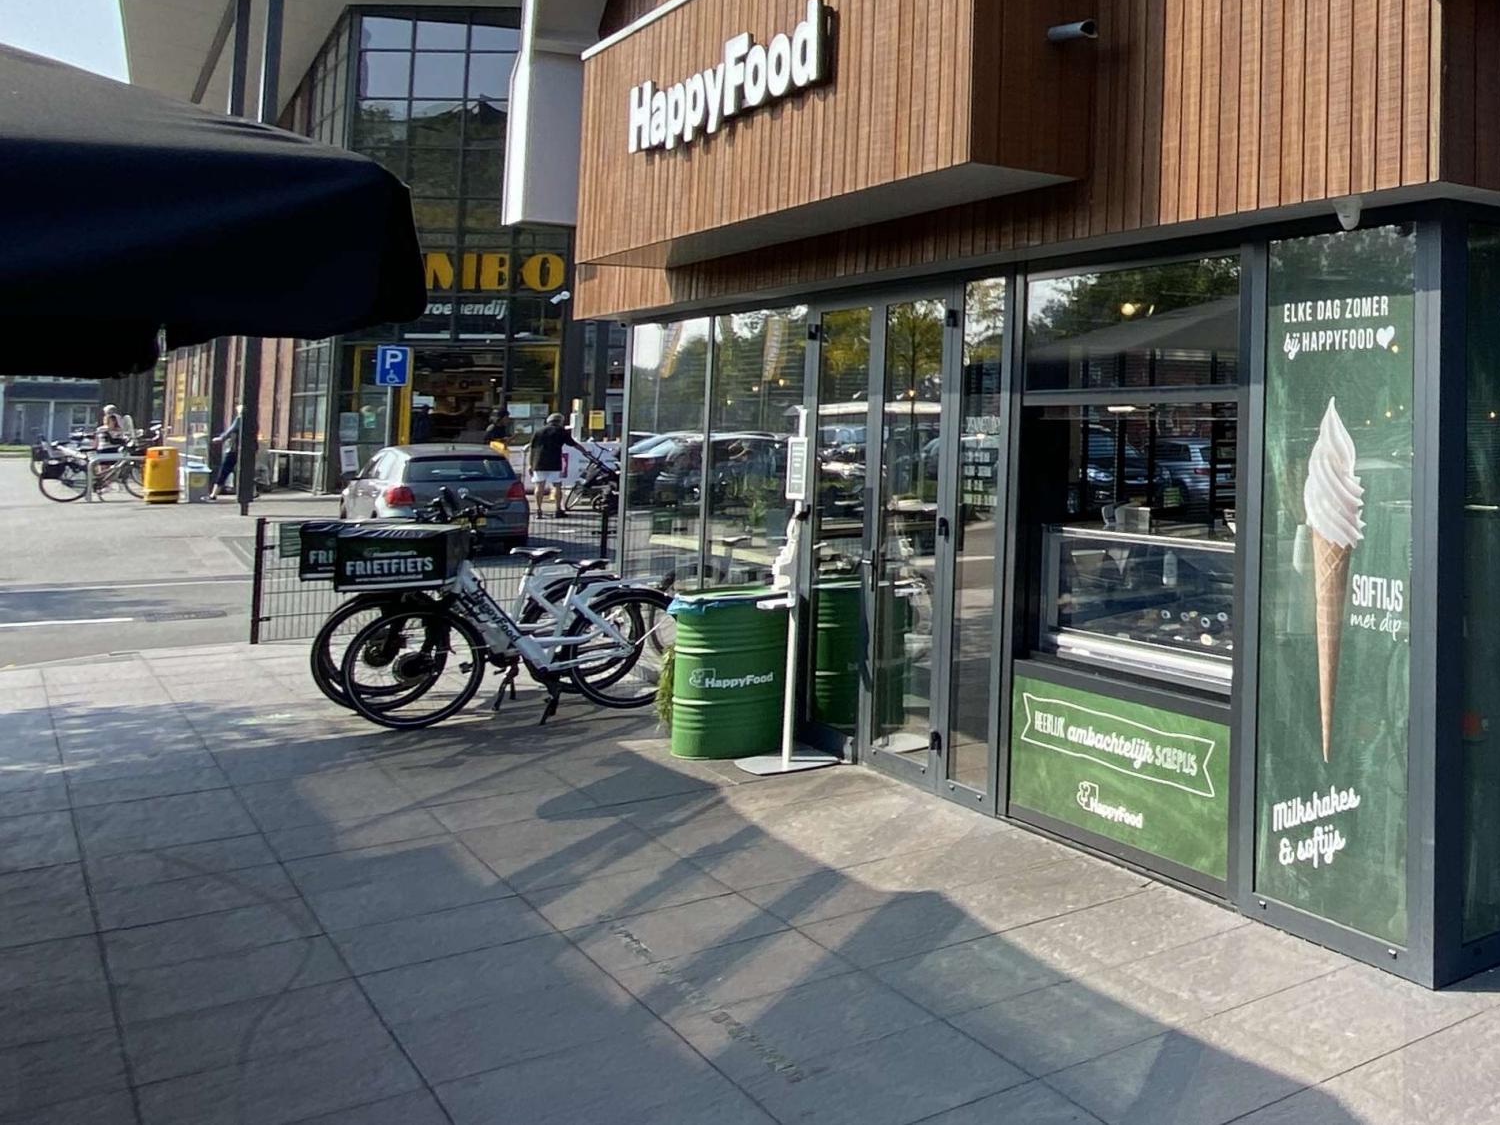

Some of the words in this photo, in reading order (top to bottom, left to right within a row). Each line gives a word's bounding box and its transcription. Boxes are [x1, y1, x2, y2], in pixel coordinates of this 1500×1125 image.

[424, 251, 566, 292] MBO
[1283, 301, 1313, 323] ELKE
[1316, 299, 1341, 321] DAG
[1344, 295, 1389, 319] ZOMER
[385, 349, 403, 370] P
[1283, 331, 1301, 361] bij
[1302, 328, 1374, 352] HAPPYFOOD
[345, 556, 434, 576] FRIETFIETS
[1351, 573, 1404, 613] SOFTIJS
[1350, 613, 1376, 631] met
[1379, 611, 1402, 642] dip
[704, 671, 774, 689] HappyFood
[1067, 726, 1155, 769] ambachtelijk
[1089, 796, 1144, 829] HappyFood
[1272, 784, 1361, 832] Milkshakes
[1279, 837, 1295, 865] &
[1296, 824, 1346, 869] softijs
